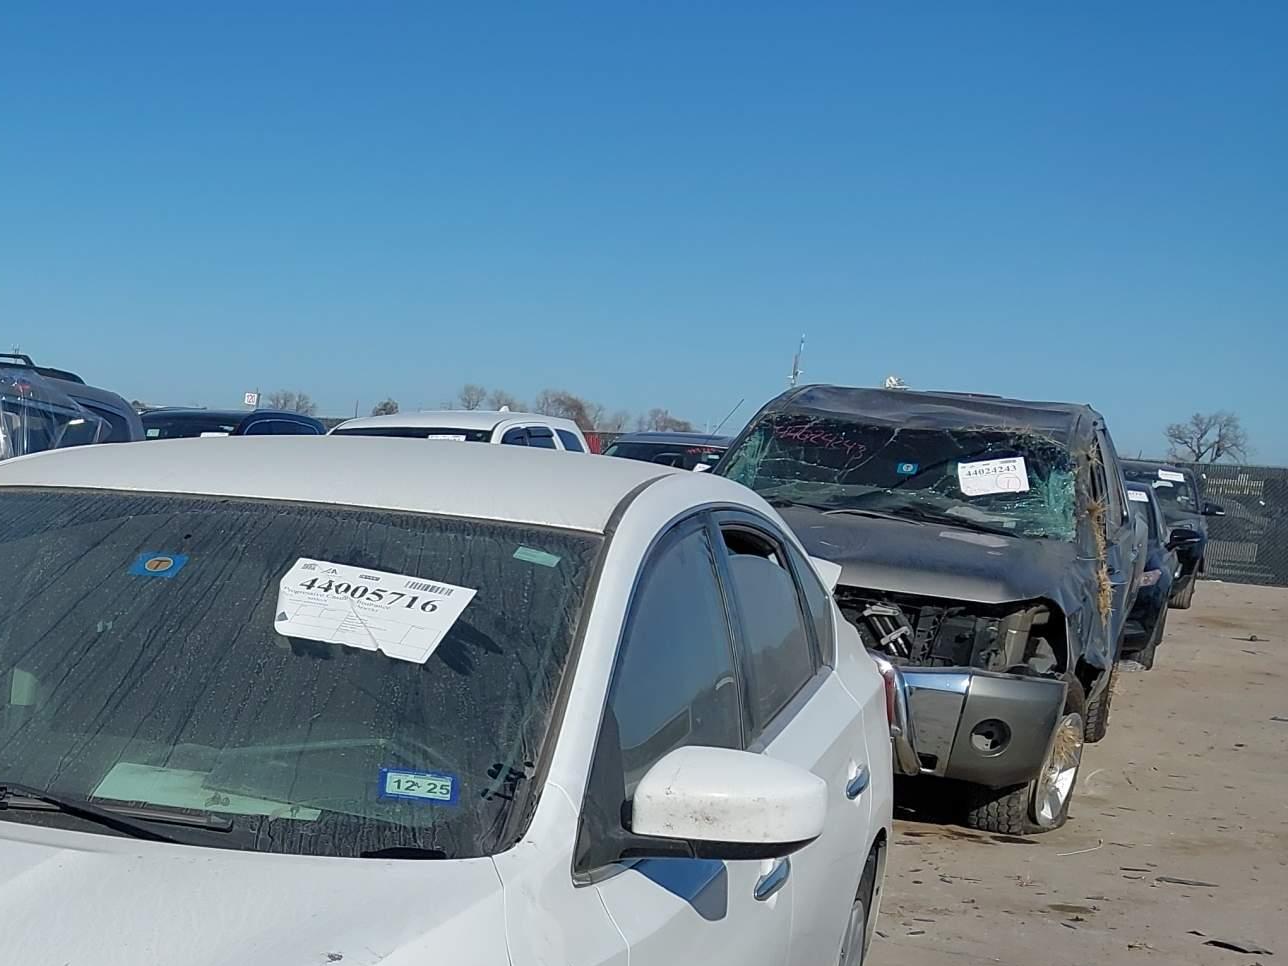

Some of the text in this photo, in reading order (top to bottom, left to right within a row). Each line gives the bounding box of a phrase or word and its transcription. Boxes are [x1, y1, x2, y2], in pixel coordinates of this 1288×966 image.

[965, 464, 1017, 477] 44024243
[299, 577, 438, 613] 44005716
[393, 778, 450, 796] 12 25
